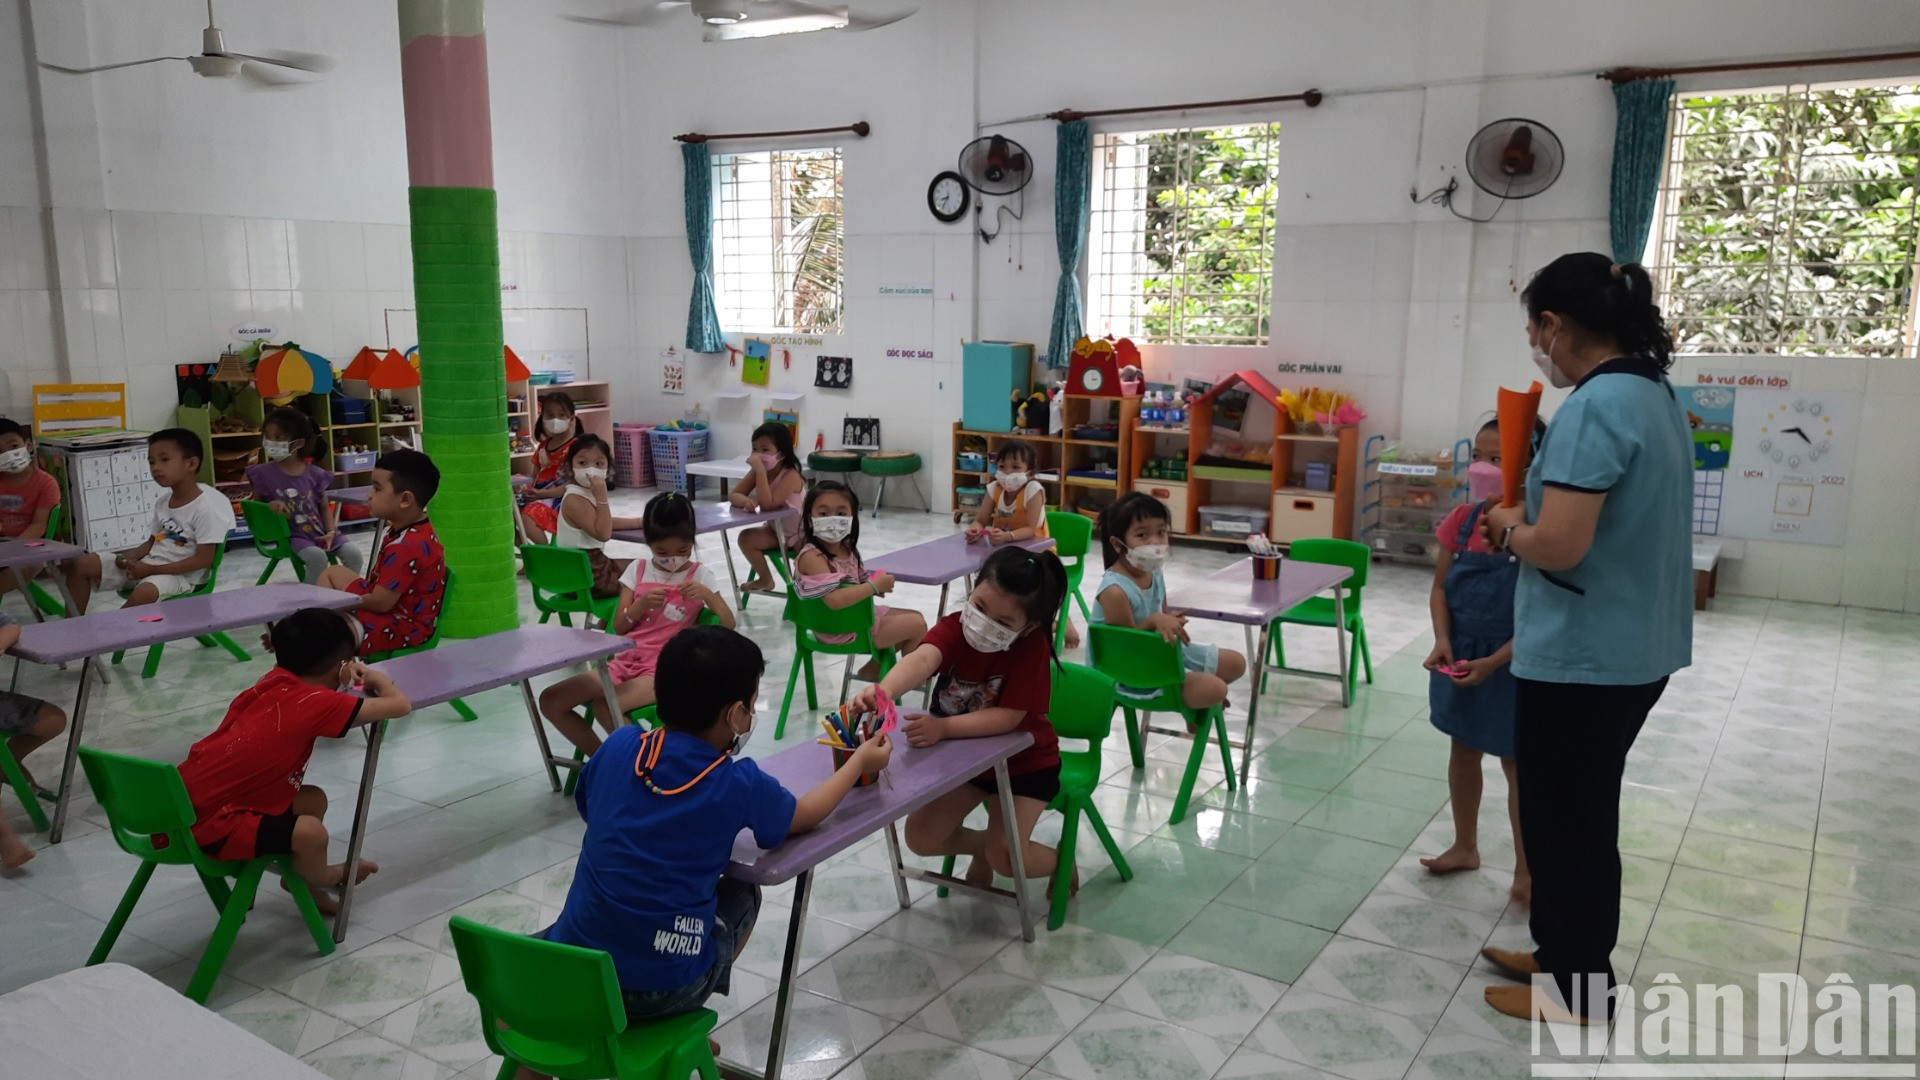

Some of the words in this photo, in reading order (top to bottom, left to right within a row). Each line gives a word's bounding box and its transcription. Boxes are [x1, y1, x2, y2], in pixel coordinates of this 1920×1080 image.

[886, 348, 900, 357] GÓC
[1278, 361, 1296, 372] GÓC
[1326, 364, 1342, 374] VAI
[1718, 375, 1735, 385] vui
[1738, 374, 1763, 386] đến
[1767, 376, 1788, 389] lớp
[1821, 475, 1845, 486] 2022
[674, 915, 704, 936] FALLEN
[653, 929, 702, 956] WORLD
